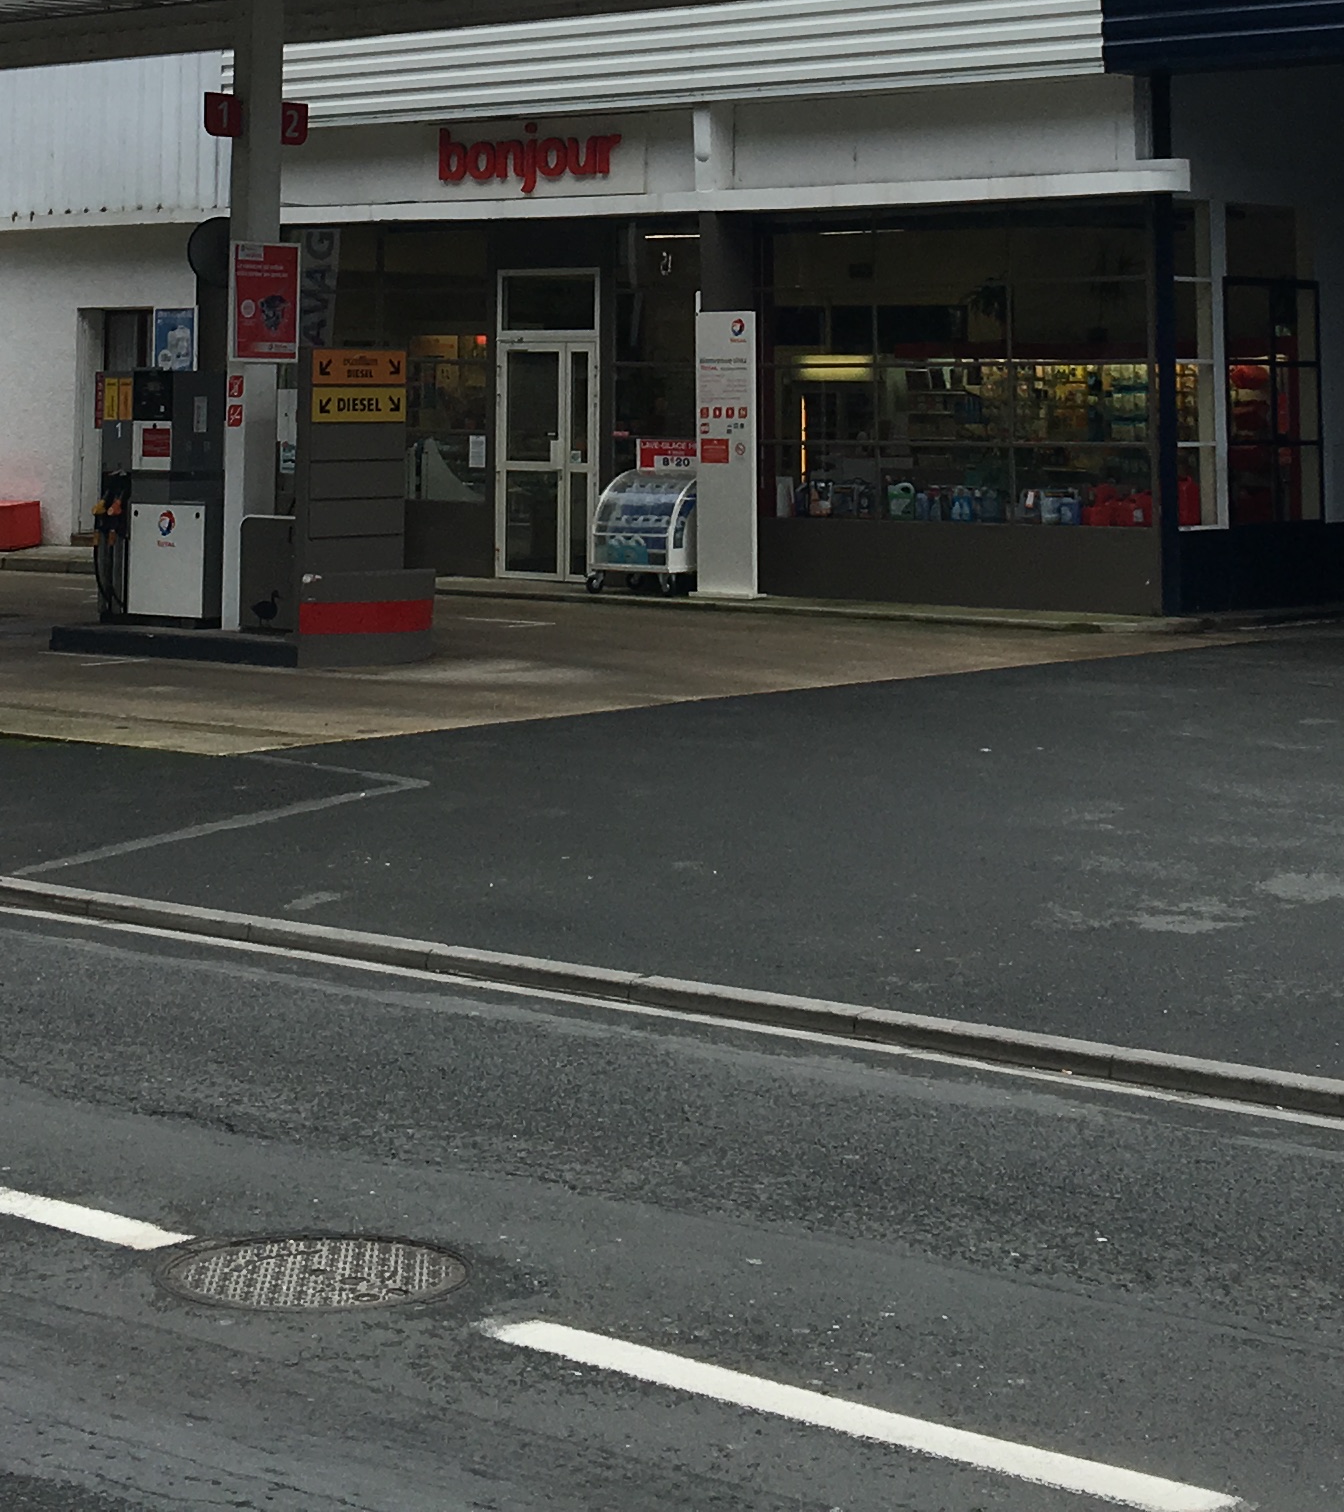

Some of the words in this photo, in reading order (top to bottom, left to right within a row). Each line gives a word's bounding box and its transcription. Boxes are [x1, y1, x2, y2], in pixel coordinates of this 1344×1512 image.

[217, 101, 229, 128] 1
[285, 109, 299, 138] 2
[438, 123, 622, 194] bonjour
[347, 369, 374, 378] DIESEL
[337, 397, 382, 412] DIESEL
